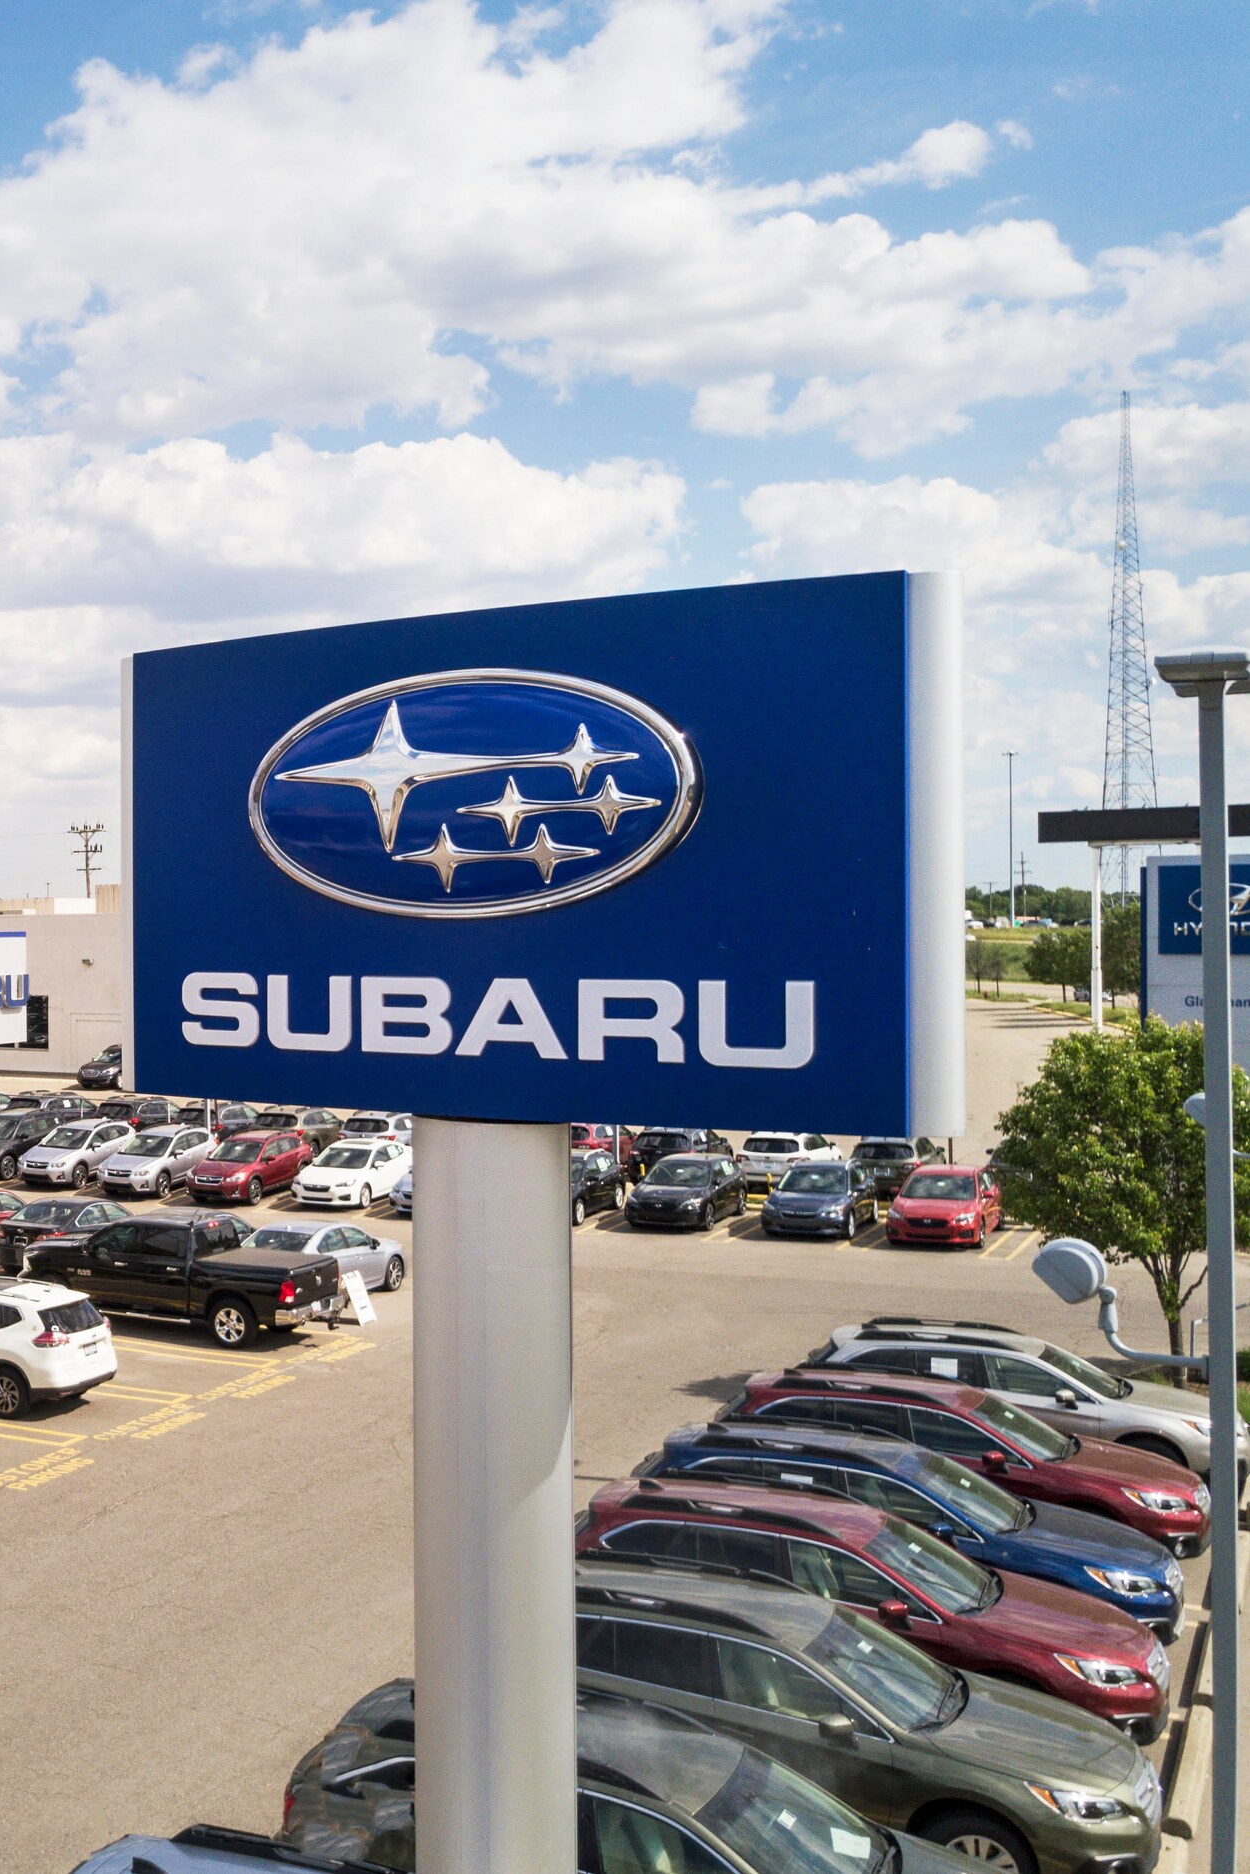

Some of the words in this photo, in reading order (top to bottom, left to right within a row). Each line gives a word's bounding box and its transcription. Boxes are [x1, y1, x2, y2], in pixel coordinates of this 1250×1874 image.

[181, 972, 815, 1069] SUBARU
[93, 1403, 196, 1441] CUSTOMER
[6, 1458, 95, 1491] PARKING
